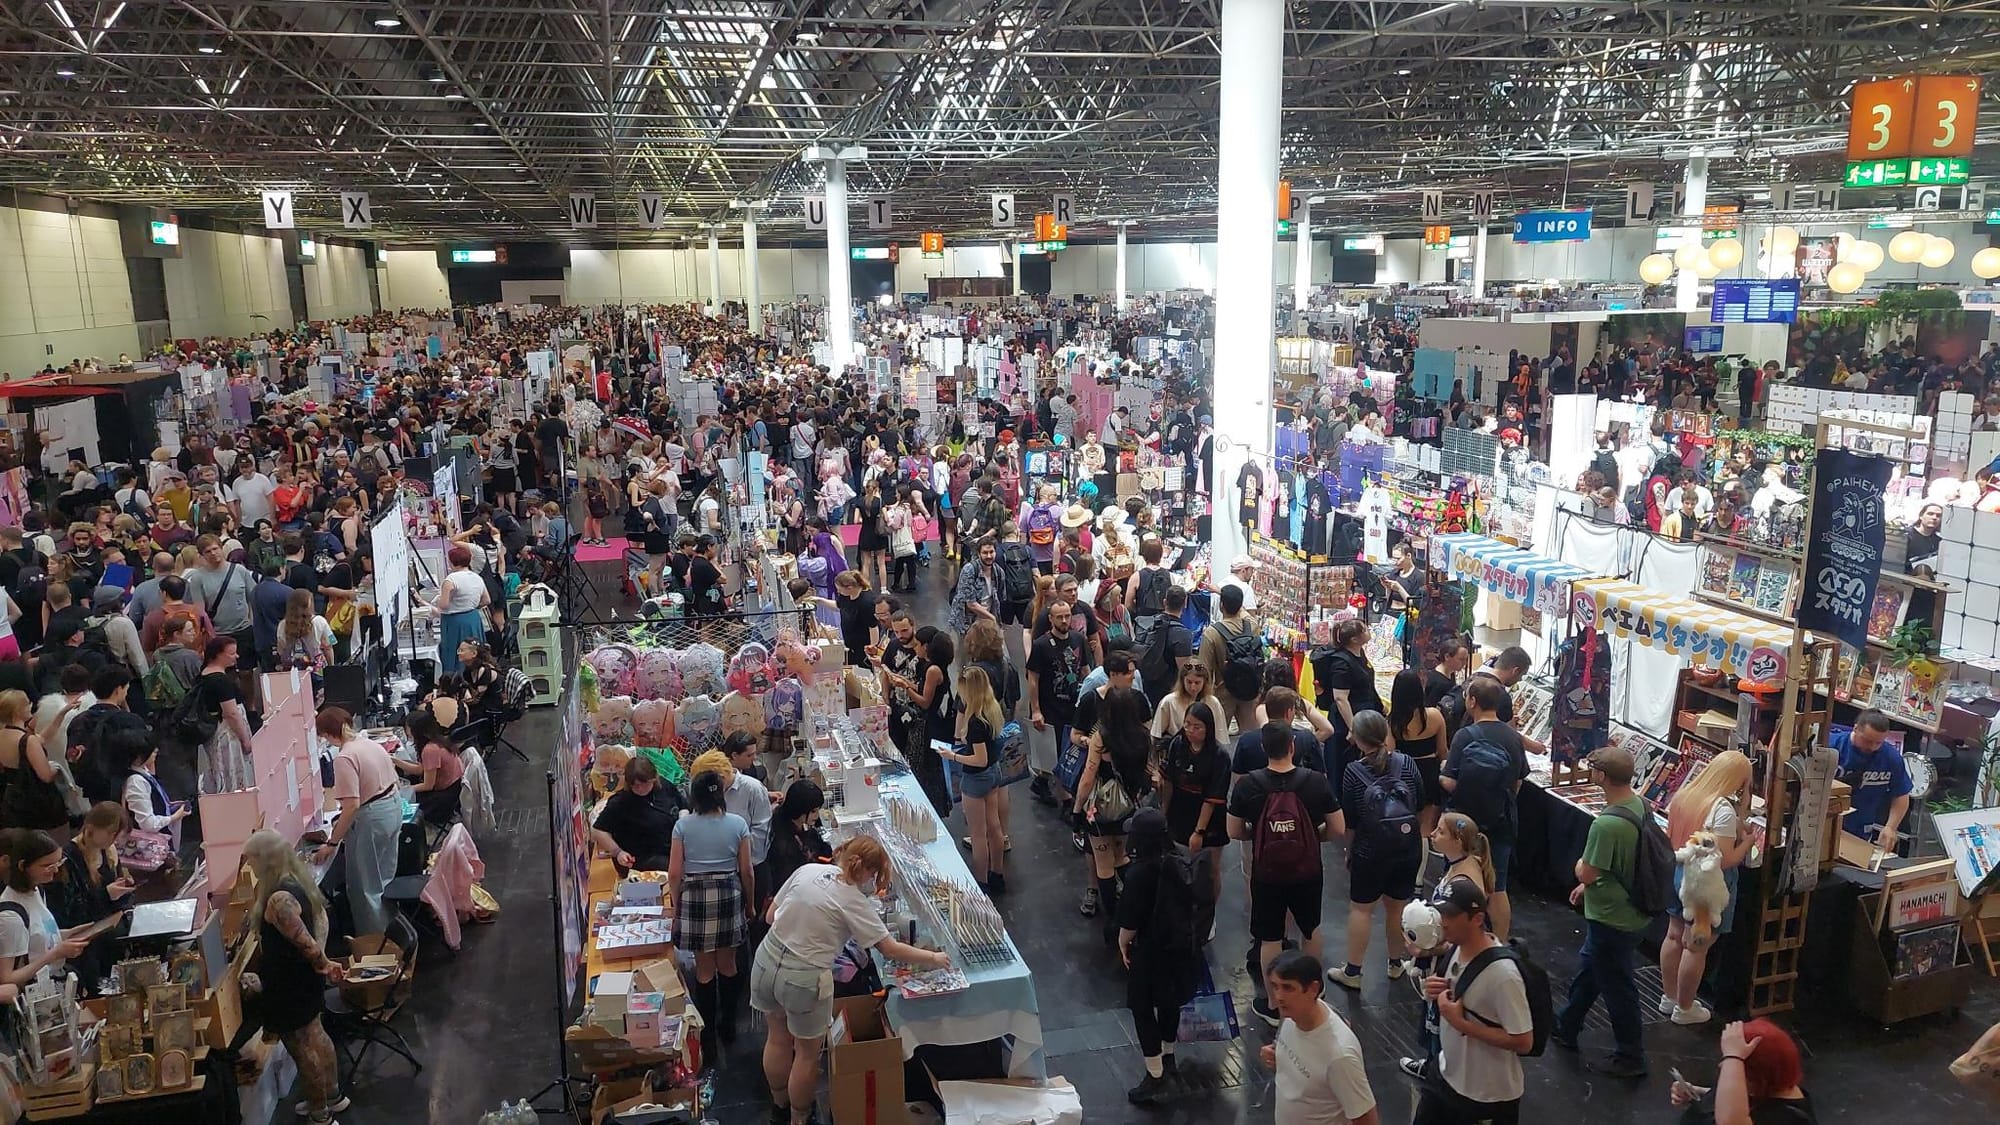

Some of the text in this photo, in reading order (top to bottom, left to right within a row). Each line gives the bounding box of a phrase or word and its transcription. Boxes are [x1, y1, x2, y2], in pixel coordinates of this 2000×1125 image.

[1867, 103, 1892, 151] 3
[1932, 100, 1958, 148] 3
[268, 197, 285, 223] Y
[347, 197, 366, 223] X
[570, 197, 595, 223] W
[641, 198, 658, 223] V
[873, 199, 886, 224] T
[997, 198, 1009, 222] S
[1058, 198, 1070, 222] R
[1290, 196, 1301, 219] P
[1426, 194, 1438, 217] N
[1475, 193, 1492, 216] M
[1631, 191, 1648, 219] L
[1817, 189, 1836, 211] H
[1916, 189, 1937, 211] G
[809, 200, 823, 225] U
[1050, 222, 1059, 239] 3
[1439, 231, 1446, 243] 3
[1537, 219, 1578, 233] INFO
[930, 237, 938, 251] 3
[1269, 820, 1296, 832] VANS
[1900, 891, 1948, 911] HANAMACHI
